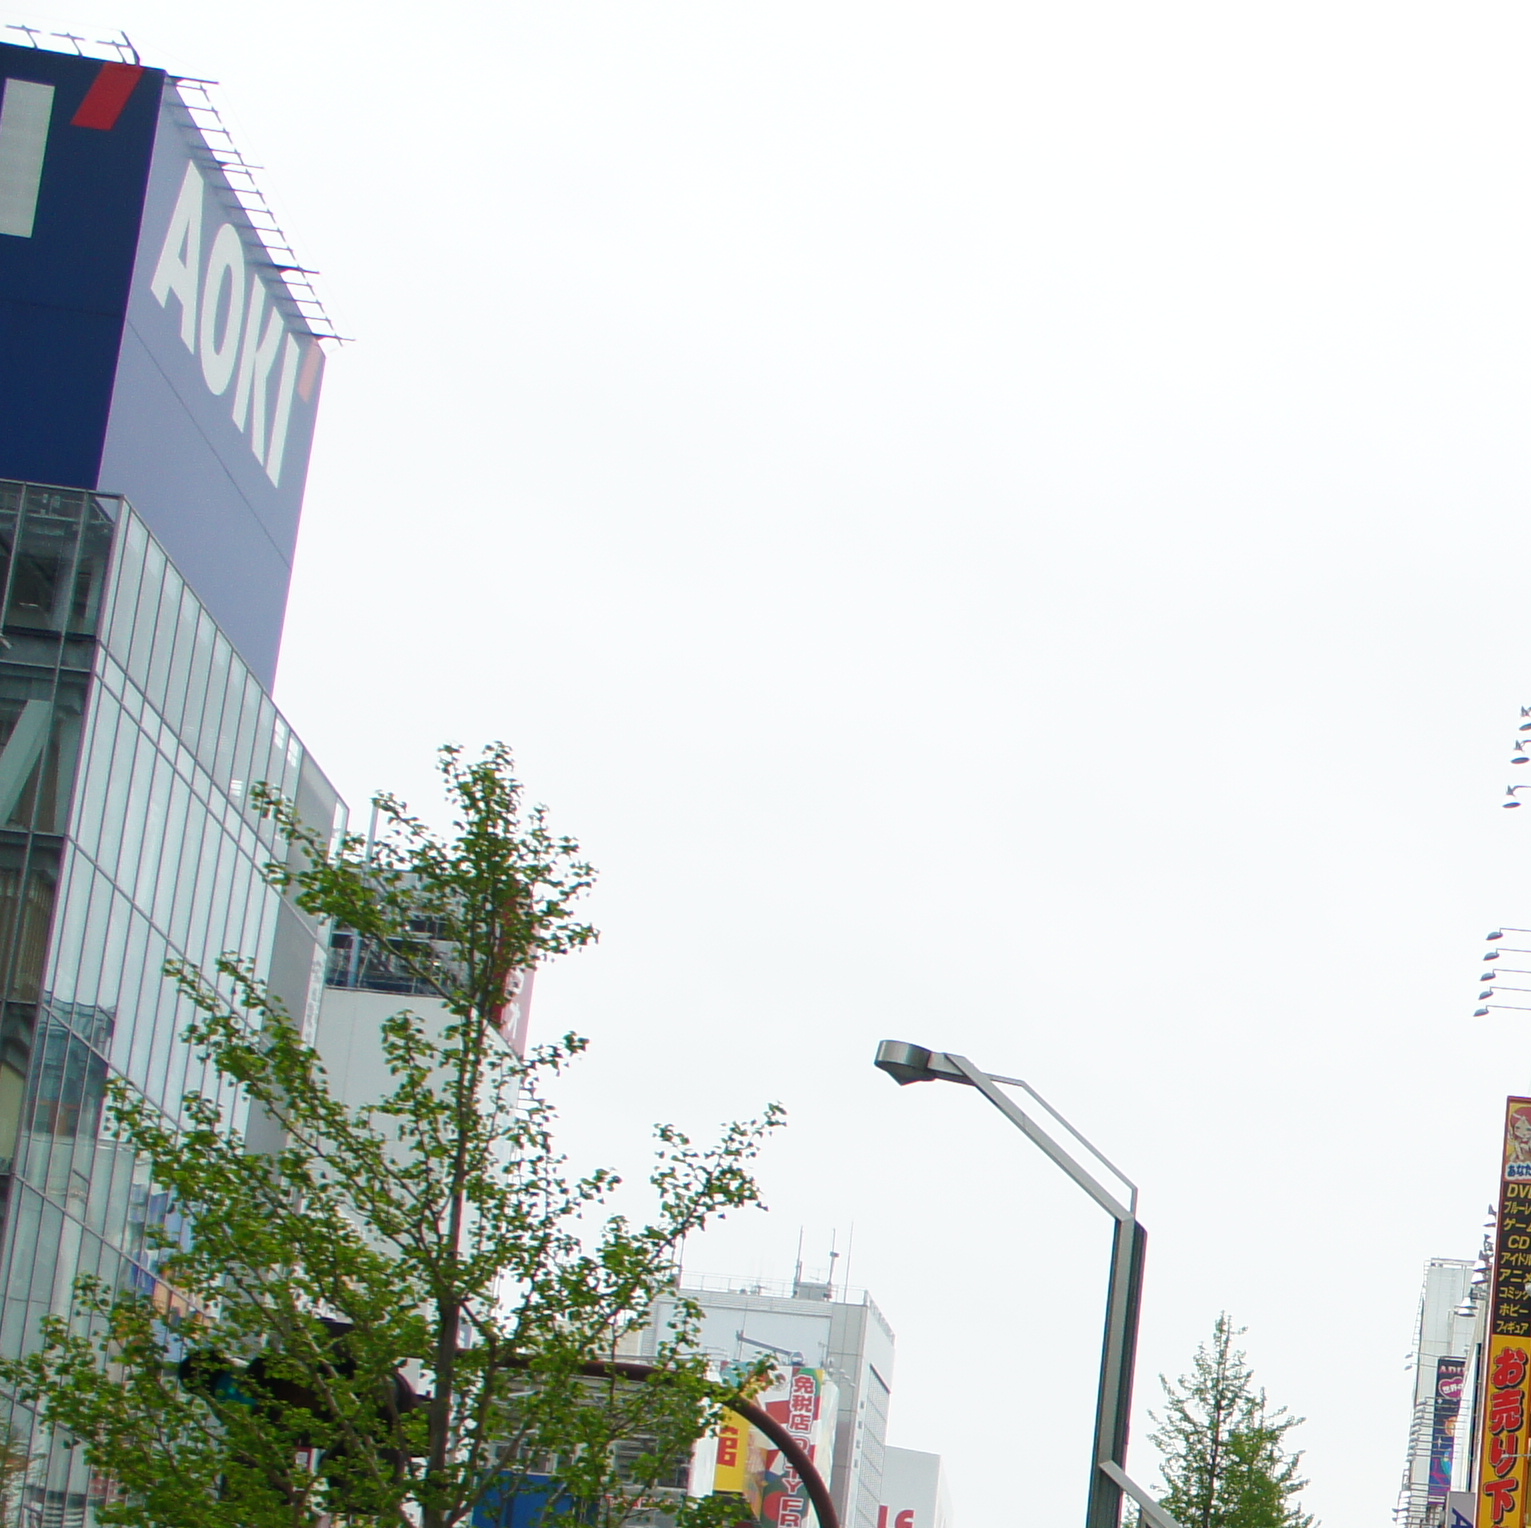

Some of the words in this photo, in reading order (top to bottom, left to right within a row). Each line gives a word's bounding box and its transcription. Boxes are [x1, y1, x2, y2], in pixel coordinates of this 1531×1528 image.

[150, 159, 301, 489] AOKI
[1507, 1235, 1530, 1250] CD
[1496, 1320, 1529, 1336] フィギュア
[1499, 1303, 1530, 1318] ホビー
[790, 1374, 815, 1432] 免税店
[782, 1434, 809, 1495] DTY
